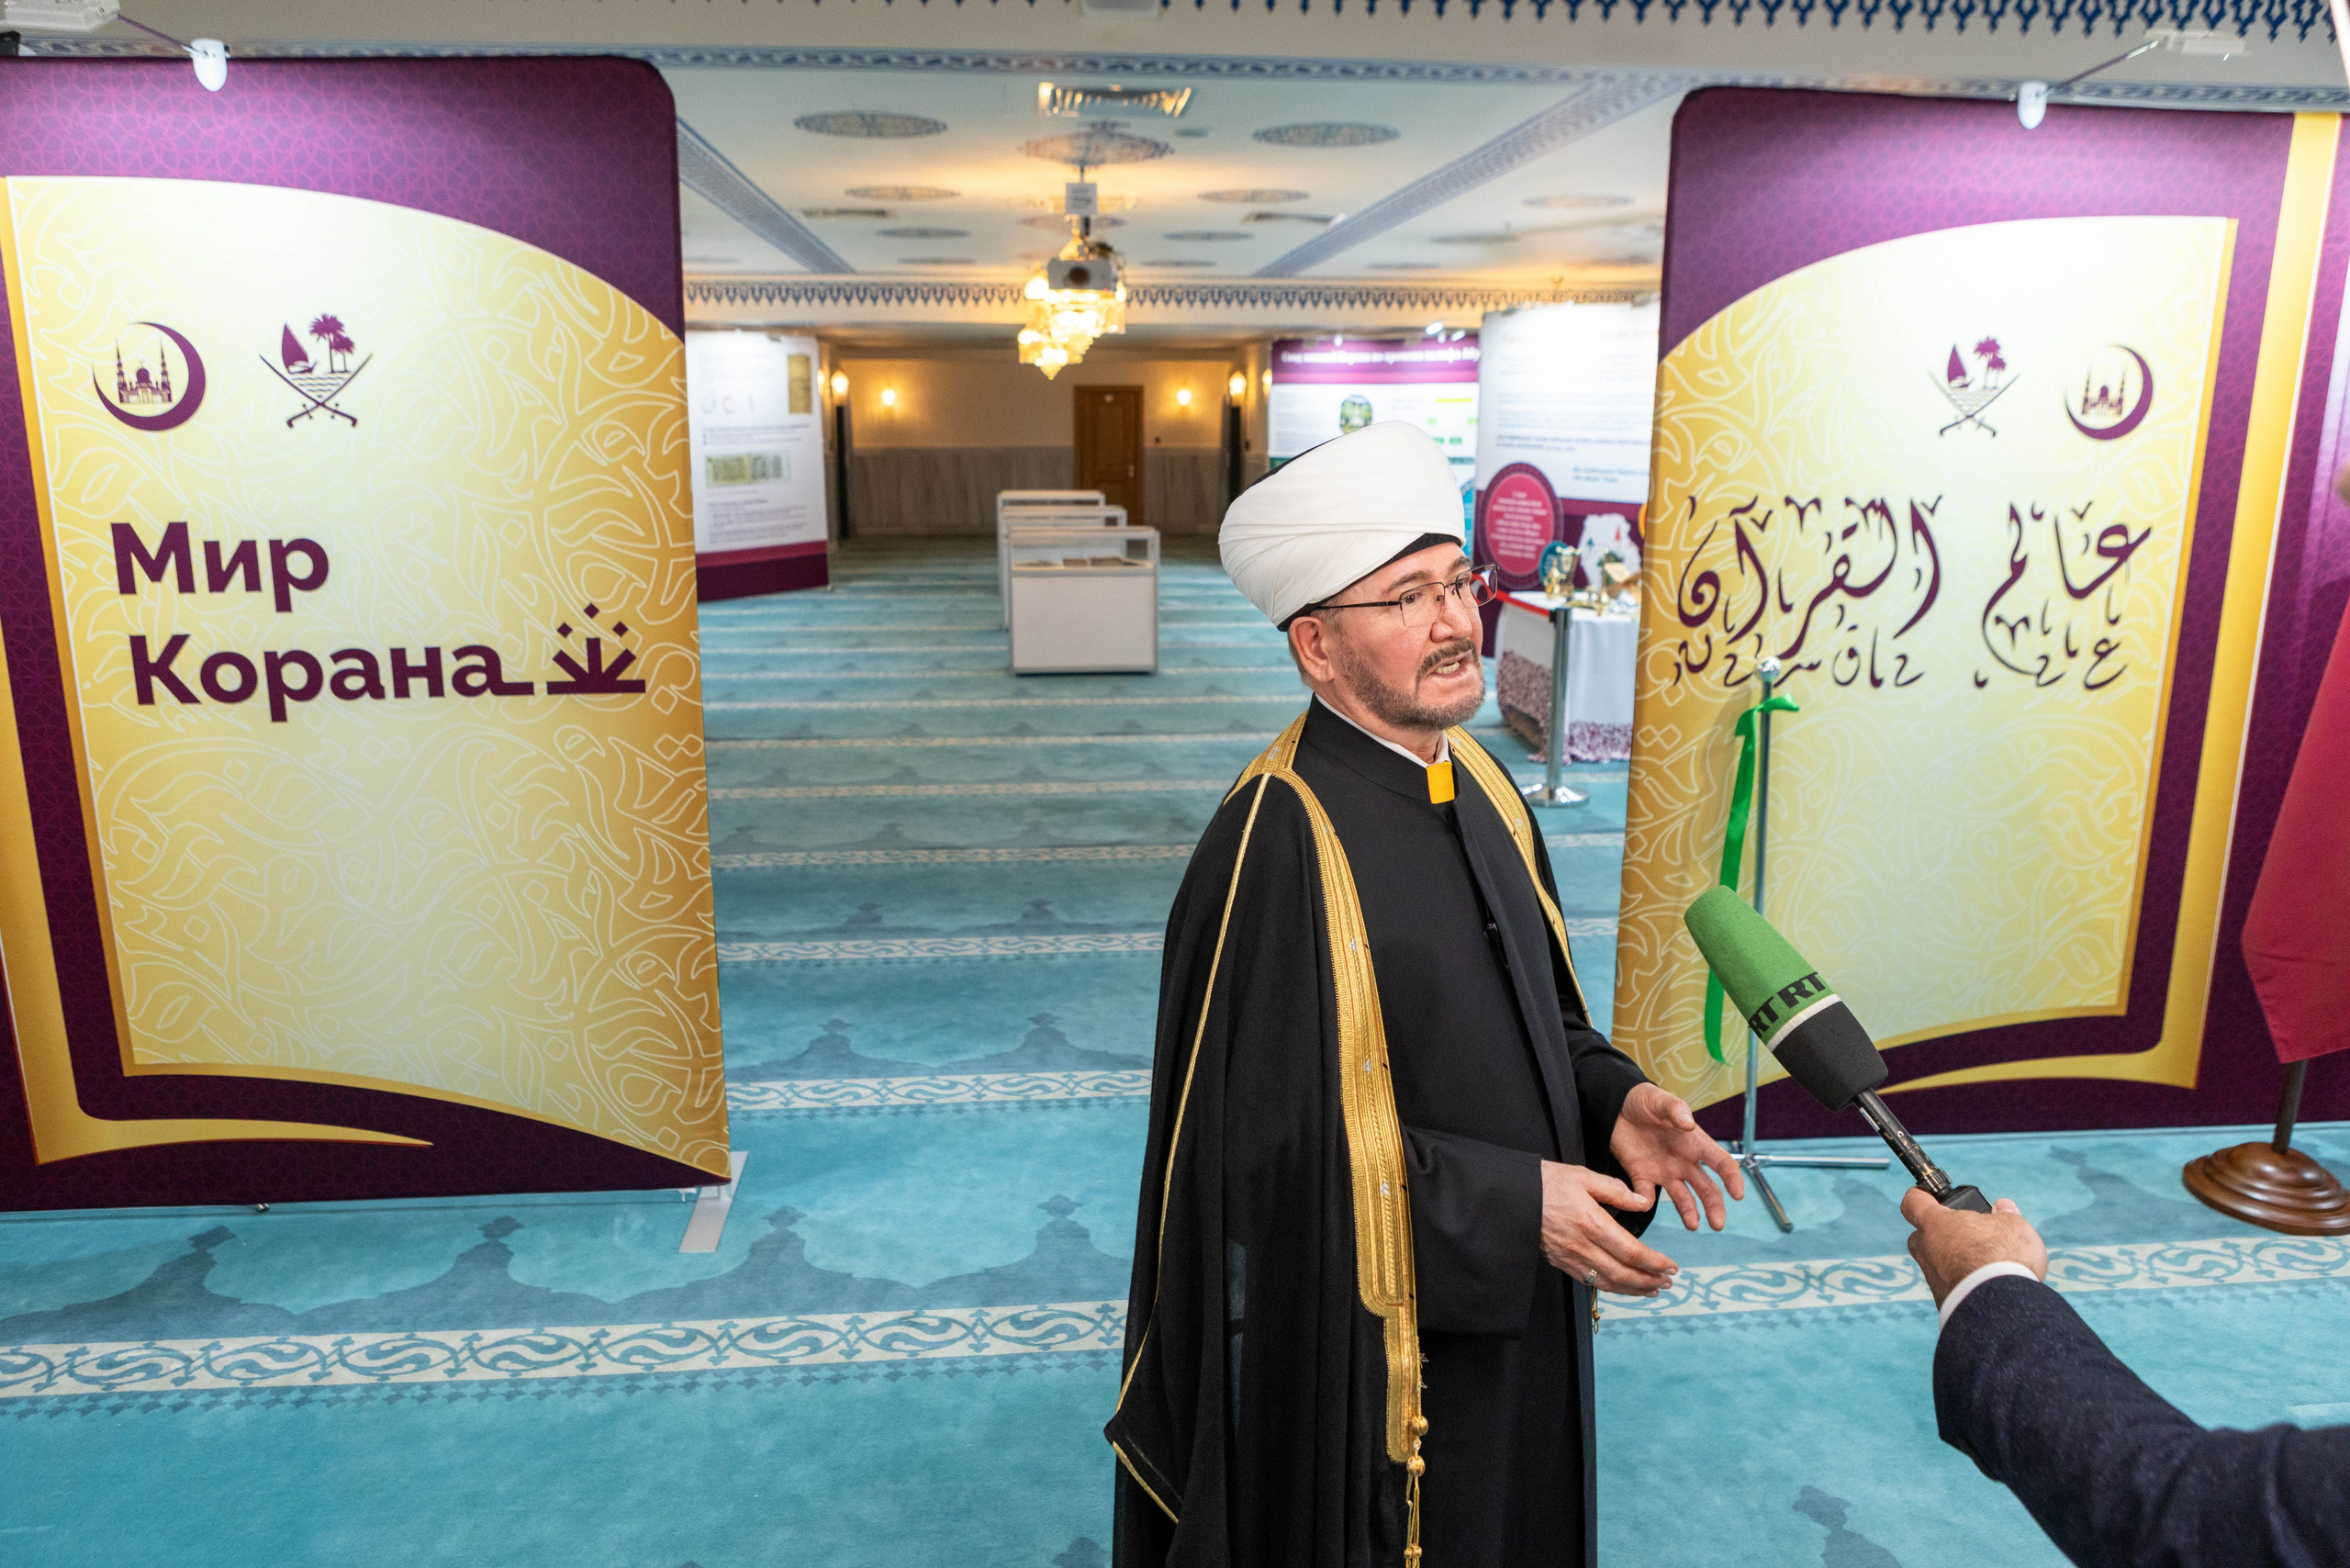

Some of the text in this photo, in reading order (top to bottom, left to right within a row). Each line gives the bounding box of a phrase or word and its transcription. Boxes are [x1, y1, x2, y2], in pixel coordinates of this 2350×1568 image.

[110, 521, 330, 612] Мир
[129, 633, 535, 722] Корана
[1748, 971, 1826, 1038] RT RT
